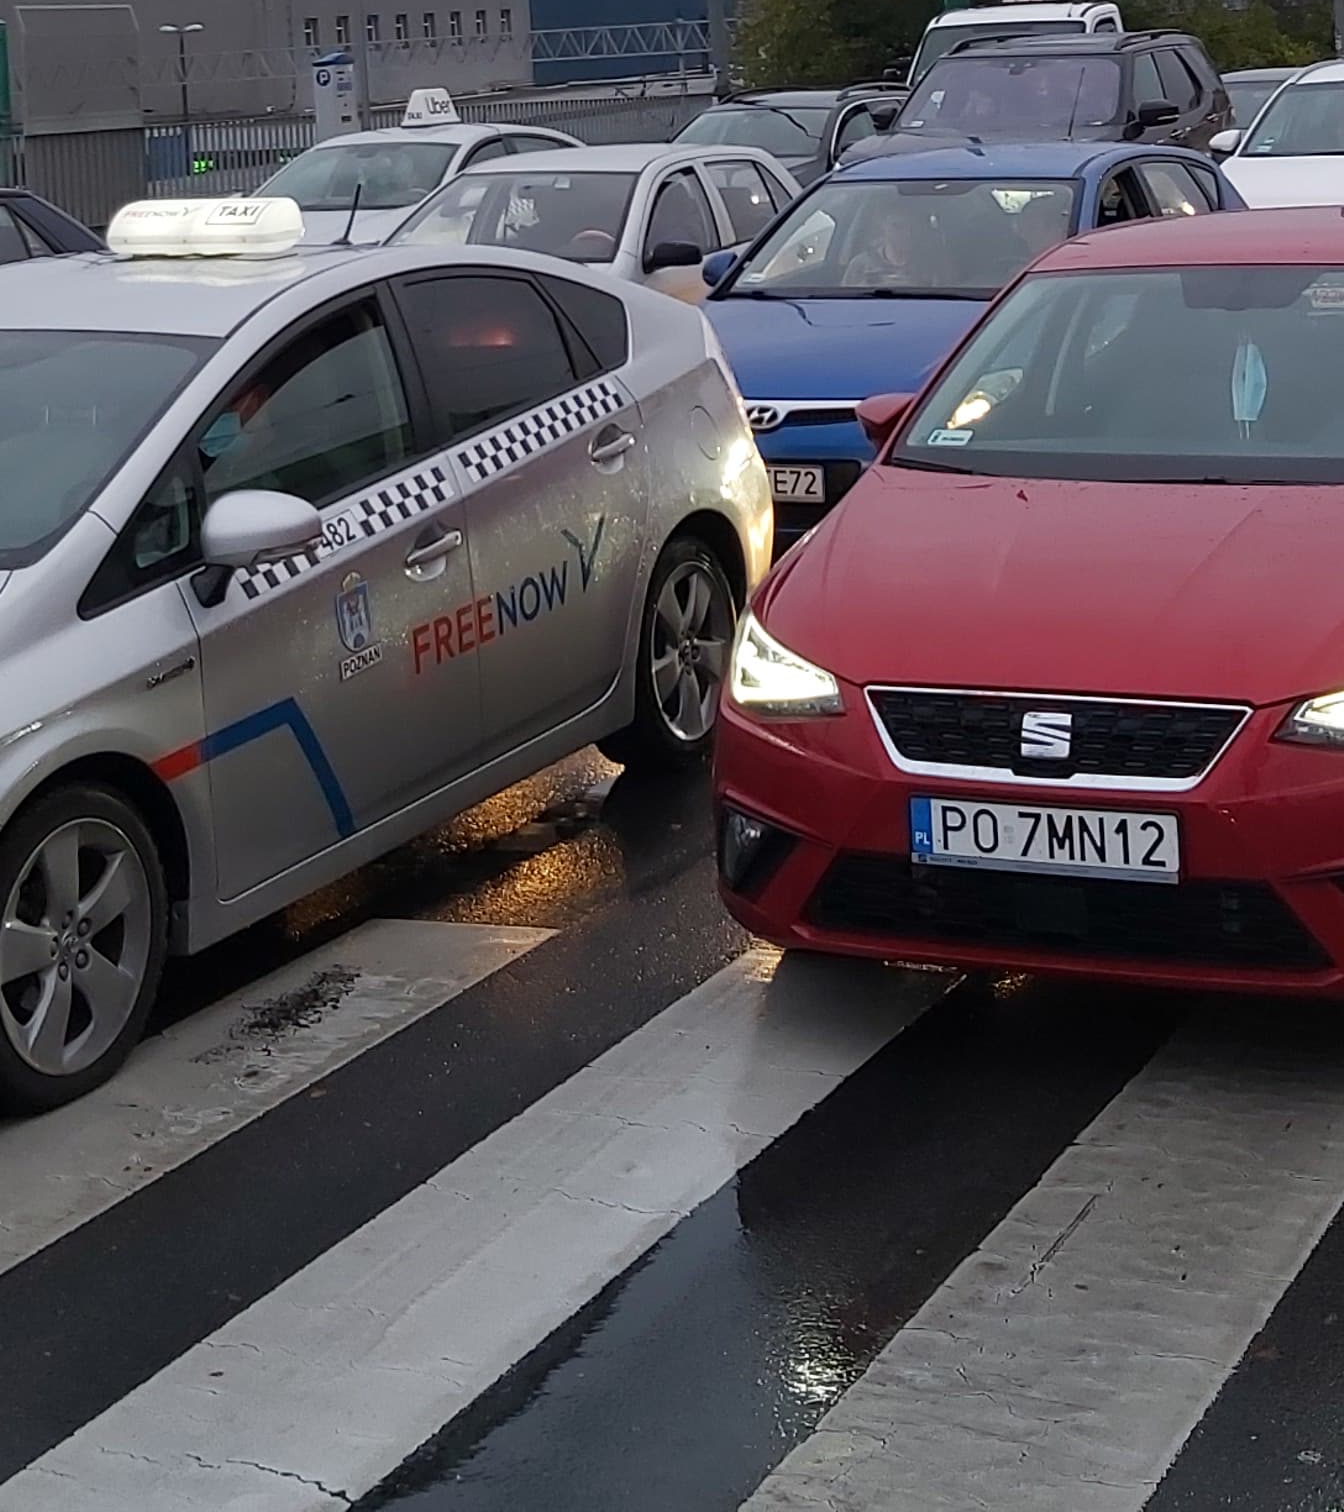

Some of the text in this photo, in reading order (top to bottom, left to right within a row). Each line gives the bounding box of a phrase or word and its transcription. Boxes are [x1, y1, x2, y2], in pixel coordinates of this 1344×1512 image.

[424, 96, 451, 114] Uber
[218, 206, 258, 217] TAXI
[766, 470, 817, 495] E72
[320, 517, 357, 551] 482
[412, 560, 568, 675] FREENOW
[914, 831, 931, 845] PL
[941, 805, 1166, 868] PO 7MN12
